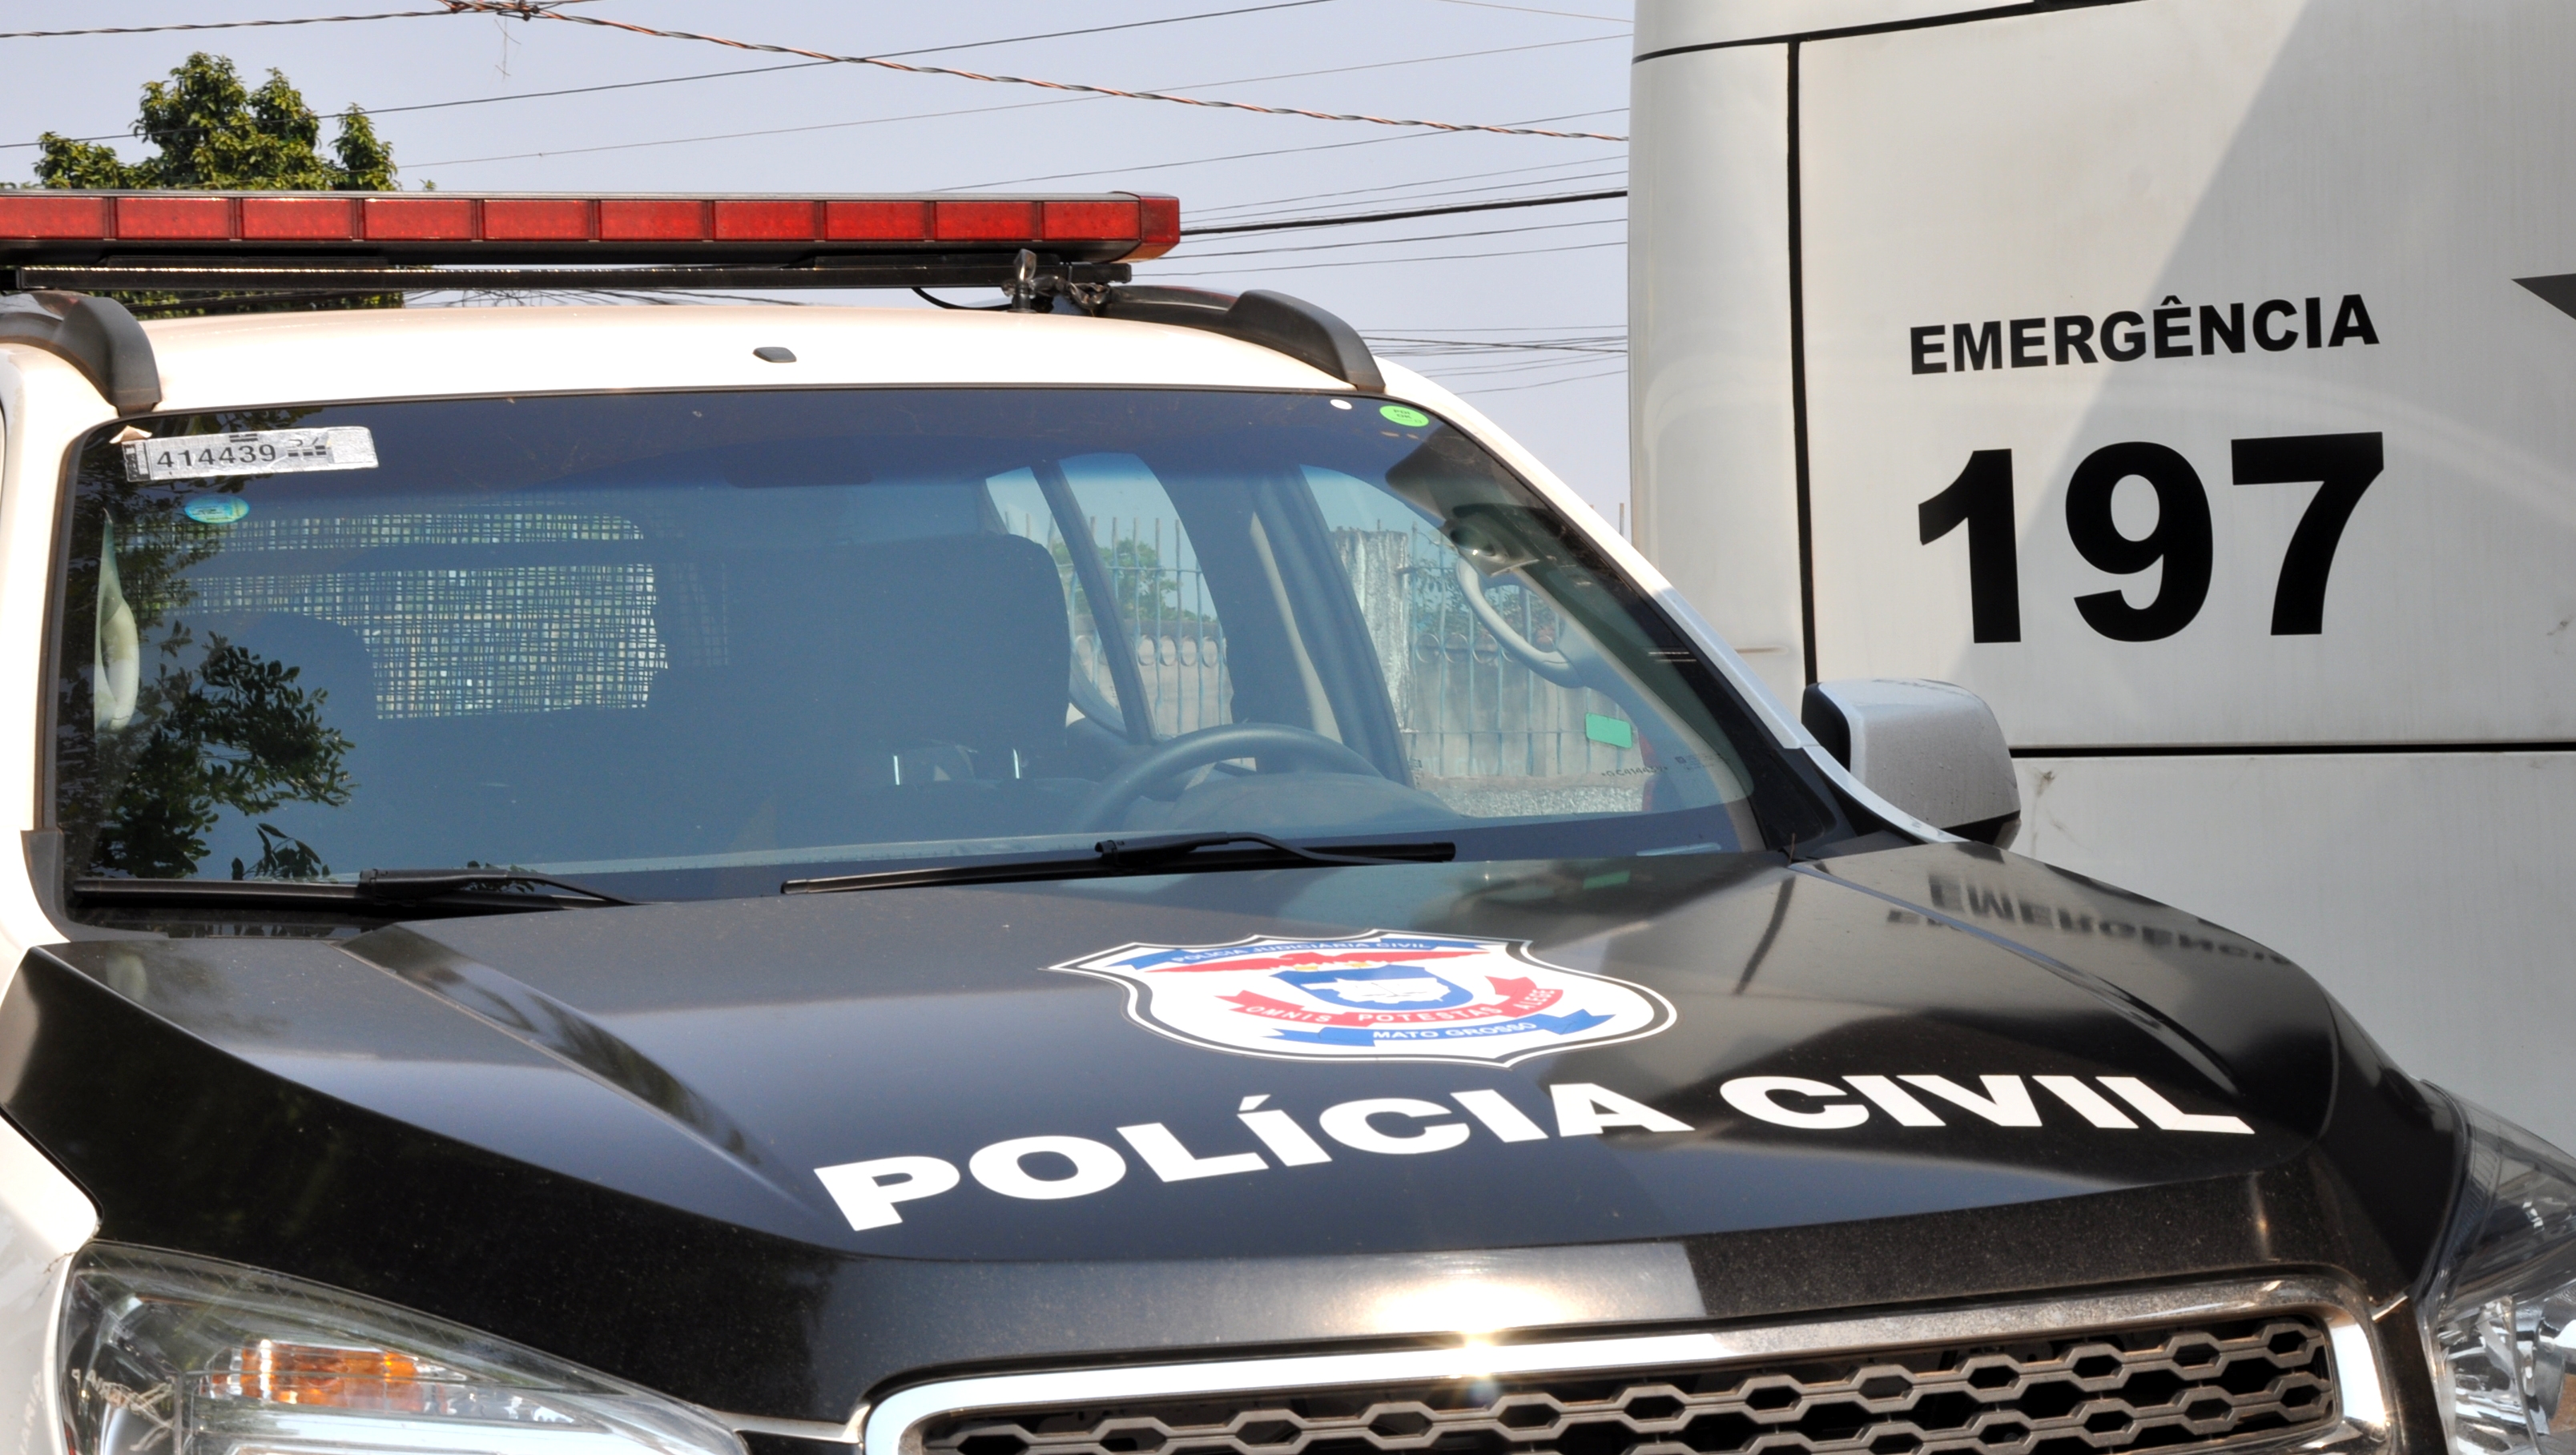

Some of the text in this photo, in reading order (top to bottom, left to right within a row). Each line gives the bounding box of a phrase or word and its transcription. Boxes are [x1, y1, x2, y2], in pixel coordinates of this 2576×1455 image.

[1910, 293, 2381, 376] EMERGÊNCIA
[156, 443, 277, 468] 414439
[1918, 431, 2385, 644] 197
[1246, 1006, 1332, 1023] OMNIS
[1358, 1007, 1503, 1022] POTESTAS
[1372, 1022, 1538, 1039] MATO GROSSO
[814, 1075, 2256, 1232] POLÍCIA CIVIL
